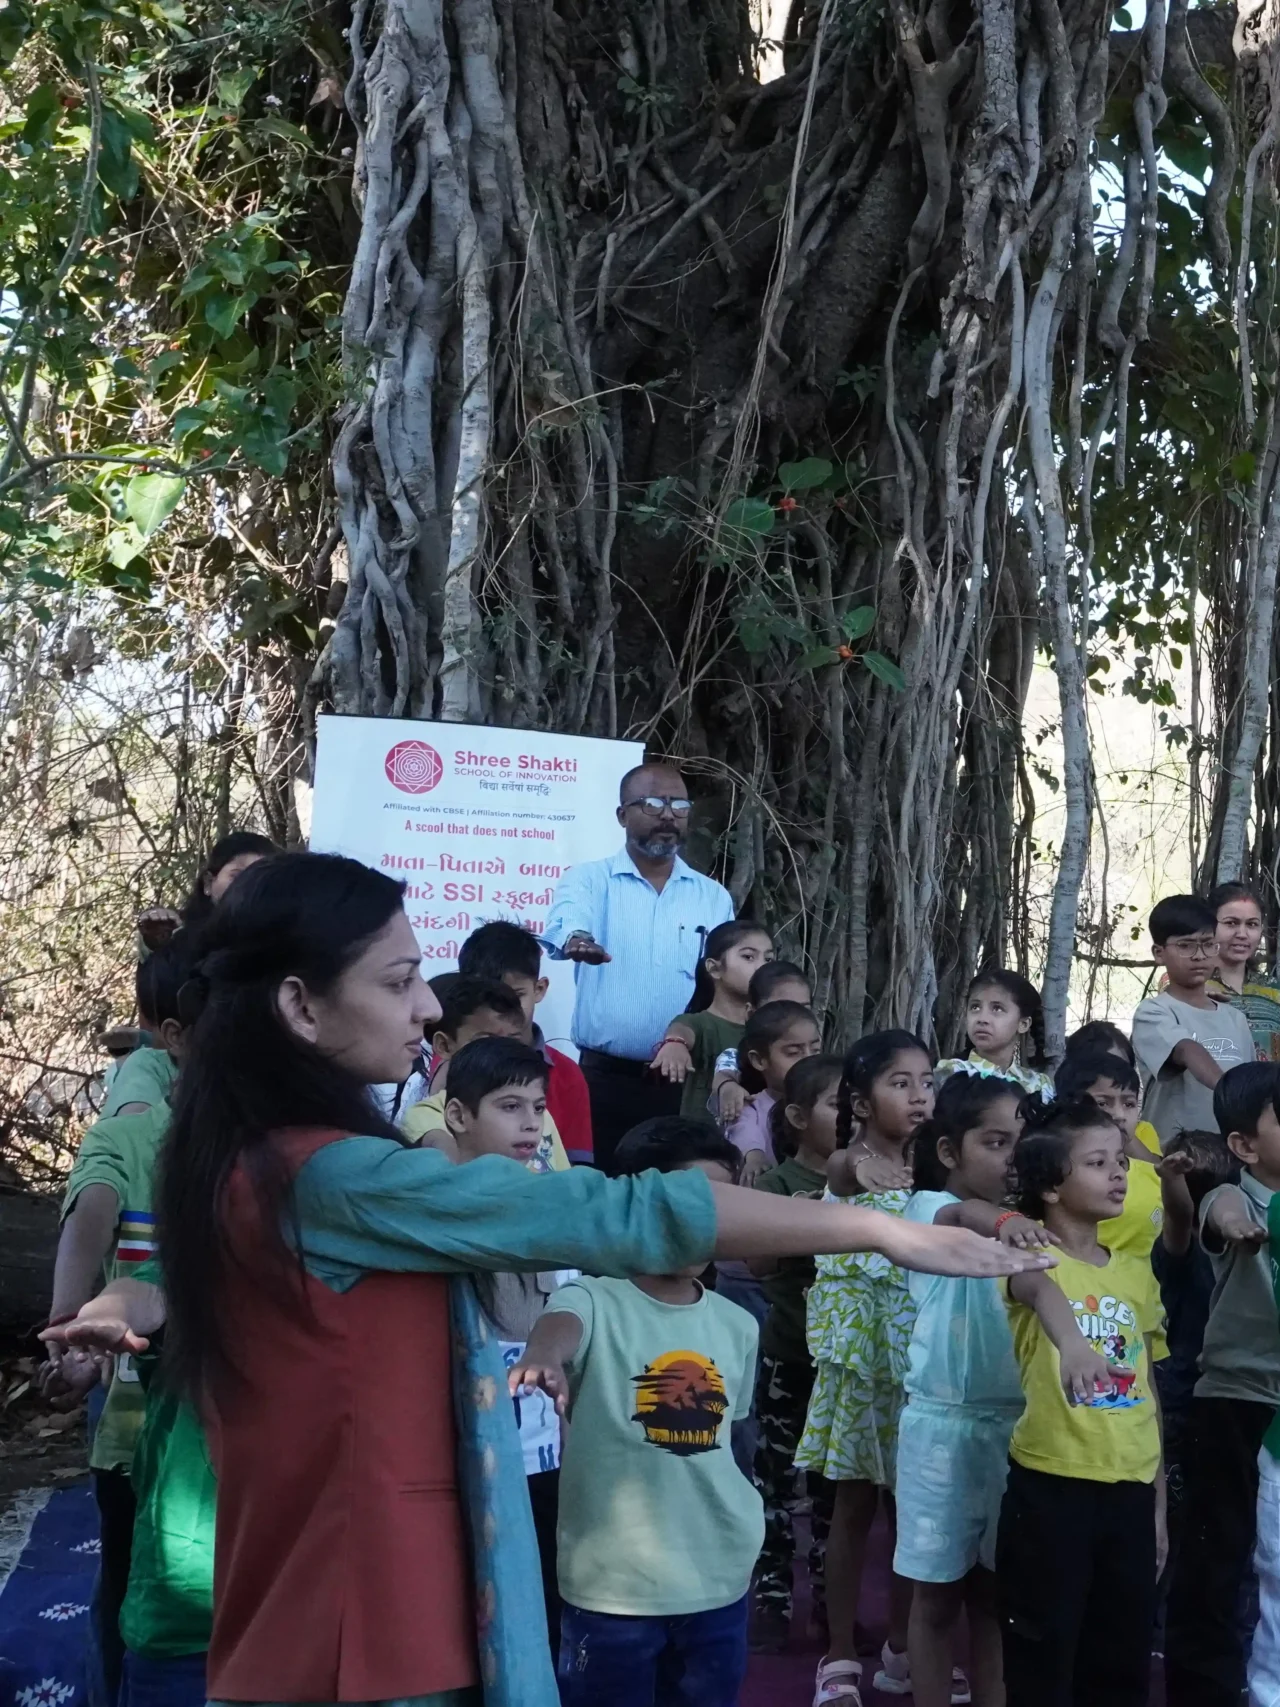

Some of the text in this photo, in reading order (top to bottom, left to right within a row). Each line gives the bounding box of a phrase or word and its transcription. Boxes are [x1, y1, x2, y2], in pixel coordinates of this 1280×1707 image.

[454, 750, 577, 773] Shree Shakti
[454, 768, 577, 783] SCHOOL OF INNOVATION
[383, 802, 421, 812] Affiliated
[423, 805, 441, 814] with
[443, 807, 465, 815] CBSE
[471, 808, 511, 818] Affiliation
[405, 819, 555, 841] A scool that does not school
[443, 882, 484, 903] SSI
